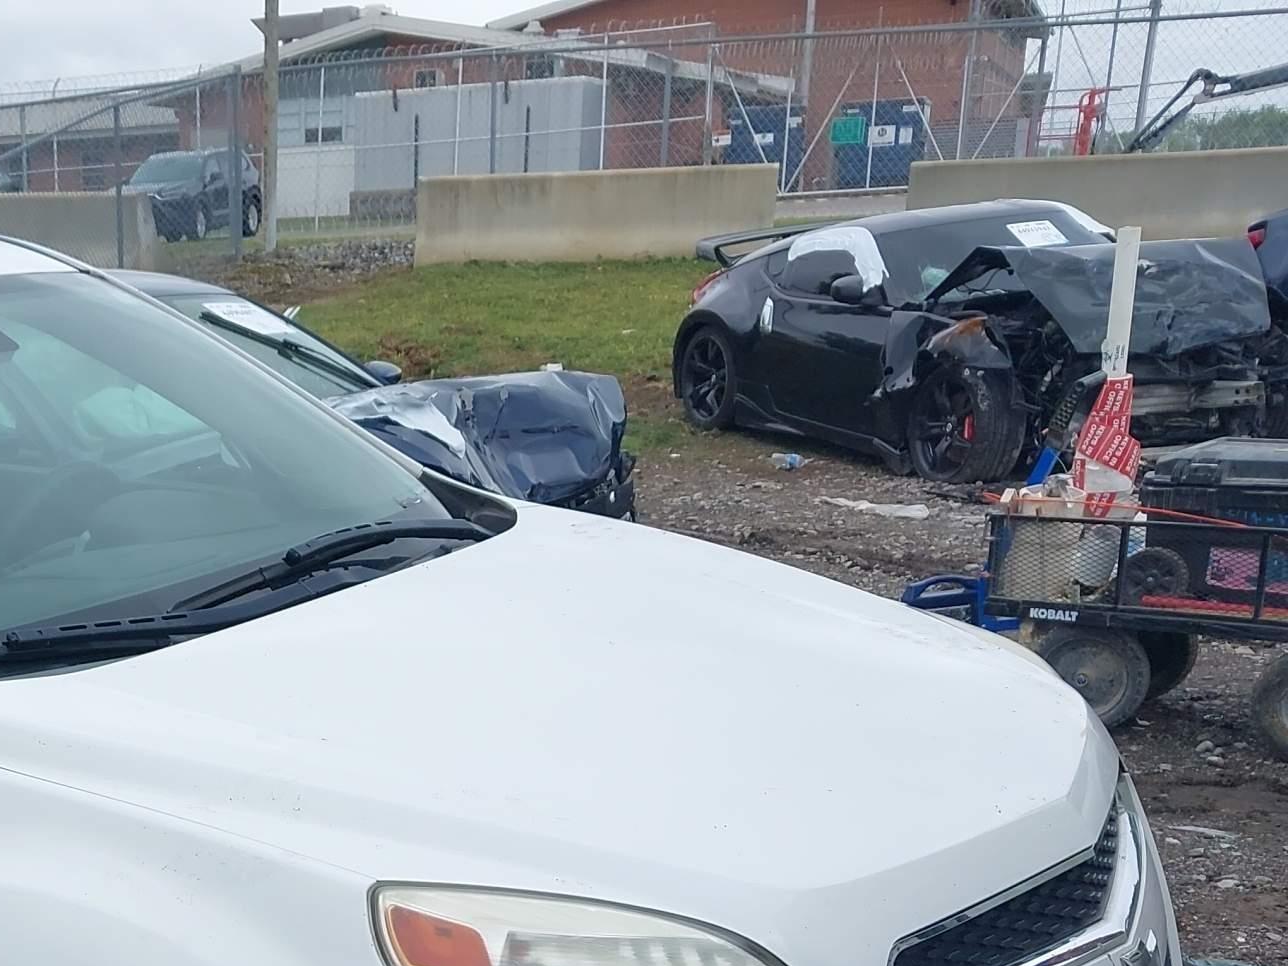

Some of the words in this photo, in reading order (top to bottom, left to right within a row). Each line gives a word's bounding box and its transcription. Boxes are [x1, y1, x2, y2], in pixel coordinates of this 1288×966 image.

[1103, 435, 1122, 461] OFFICE
[1115, 436, 1129, 457] KEYS
[1029, 607, 1079, 622] KOBALT
